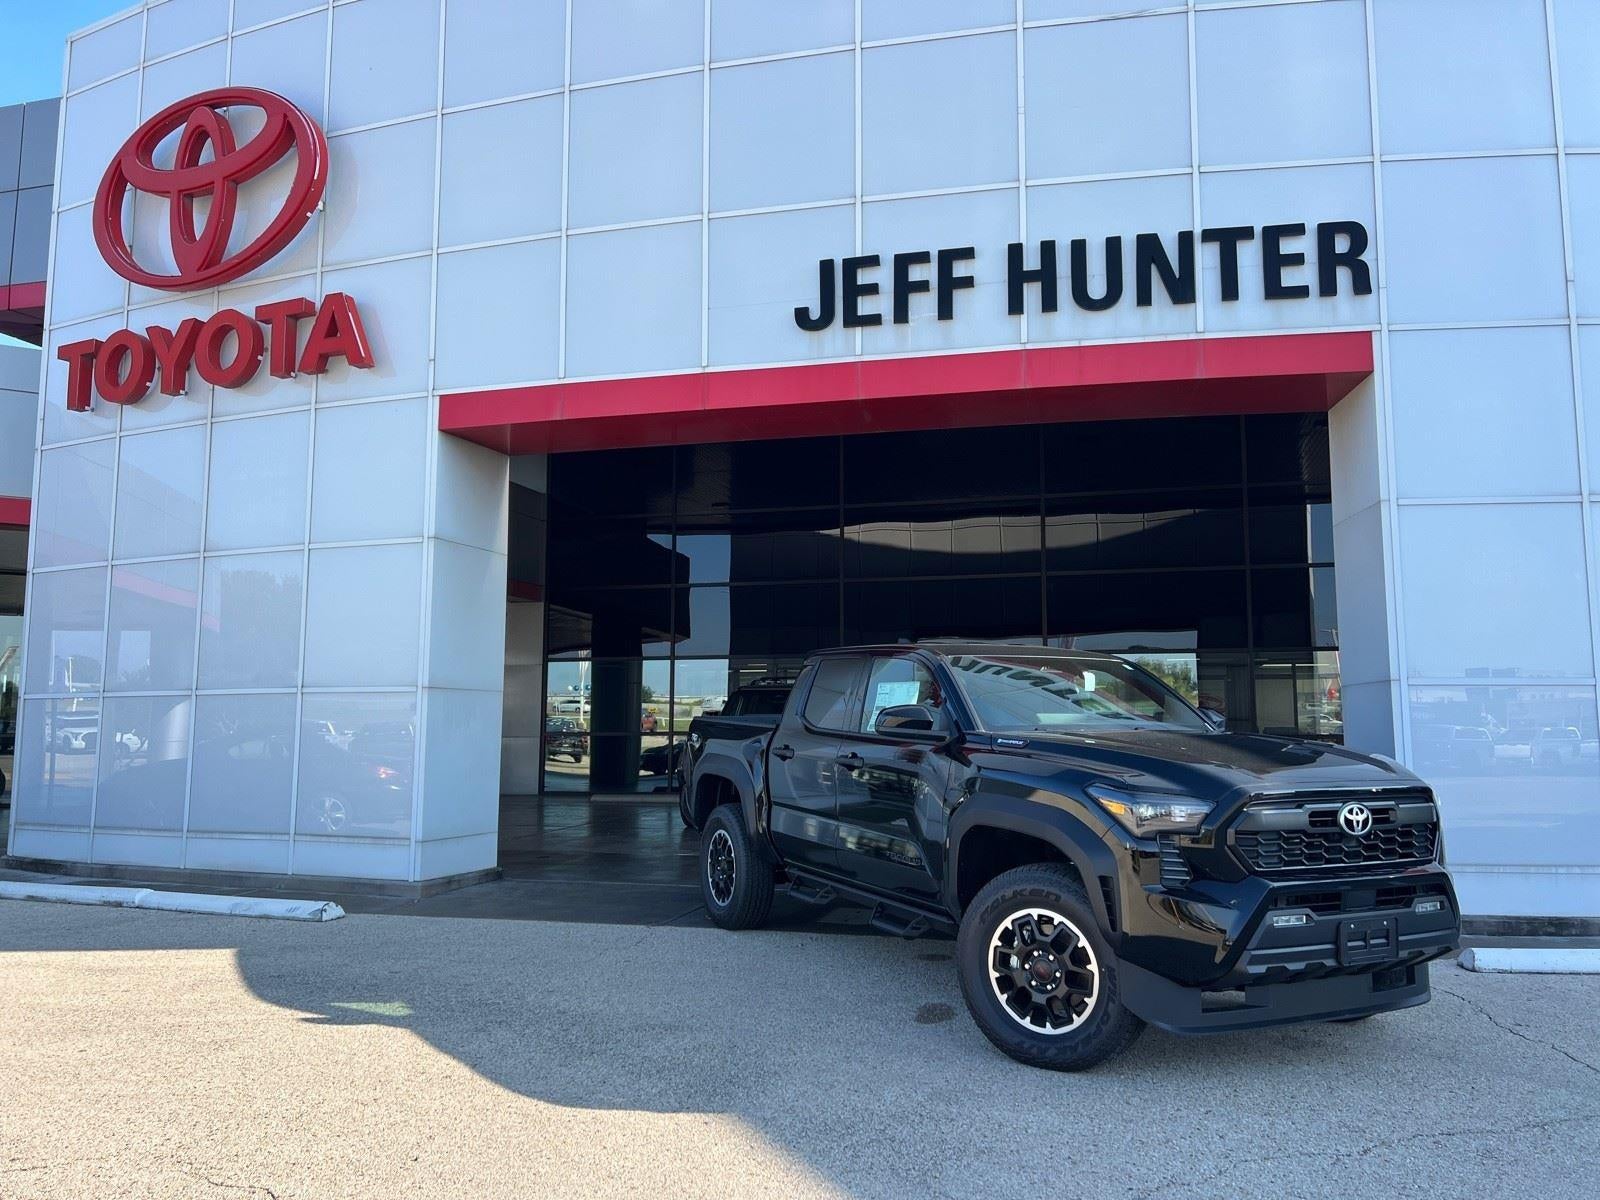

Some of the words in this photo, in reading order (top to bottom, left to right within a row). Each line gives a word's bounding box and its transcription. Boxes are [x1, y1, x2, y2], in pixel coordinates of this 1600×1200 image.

[794, 246, 976, 332] JEFF
[1007, 220, 1373, 316] HUNTER
[58, 292, 375, 412] TOYOTA
